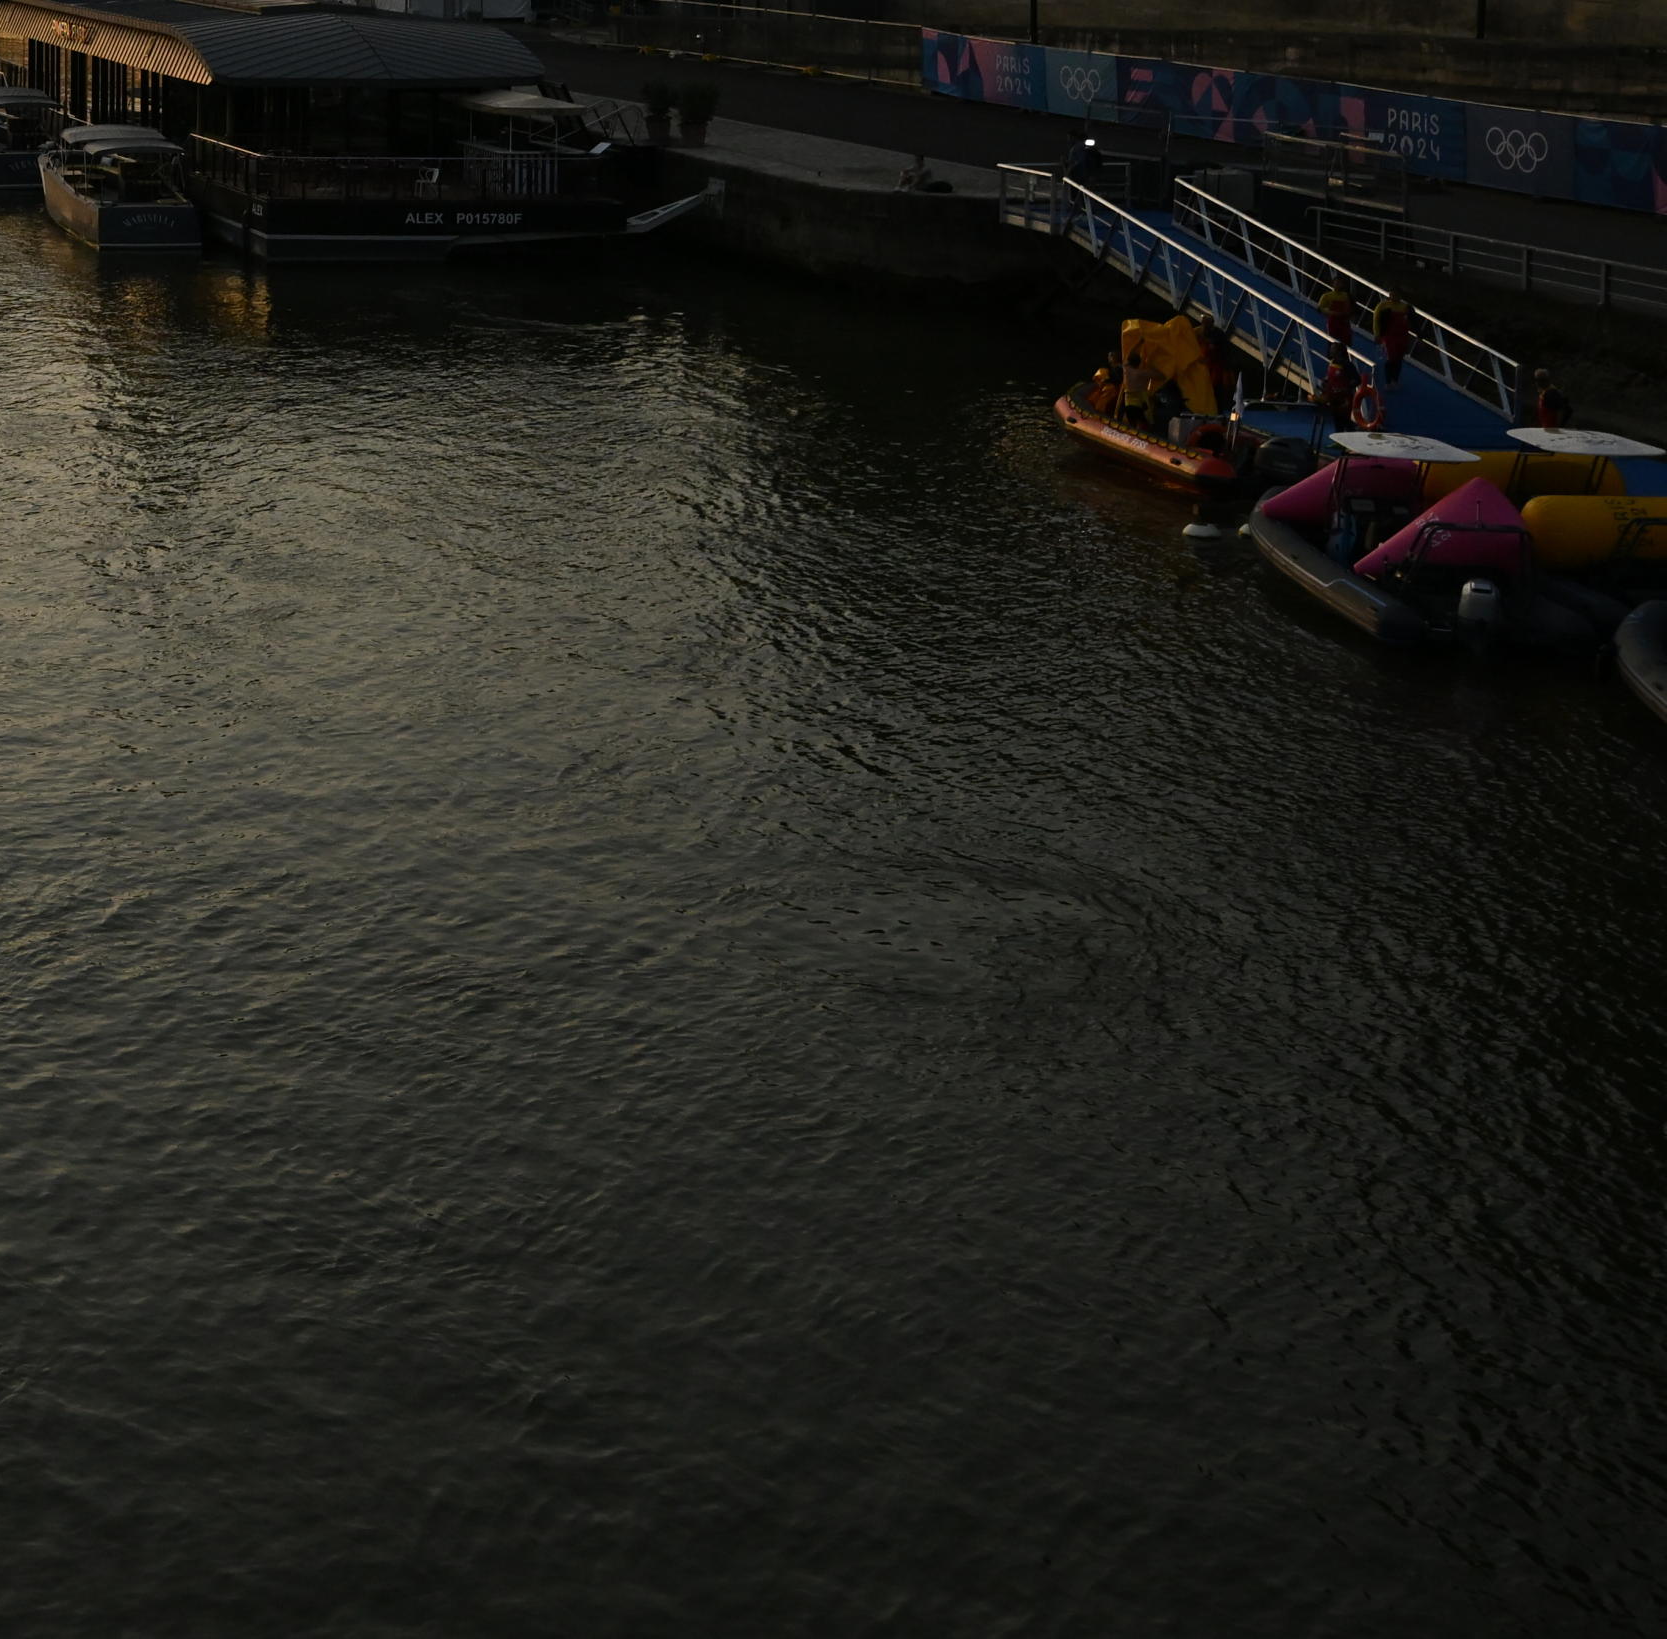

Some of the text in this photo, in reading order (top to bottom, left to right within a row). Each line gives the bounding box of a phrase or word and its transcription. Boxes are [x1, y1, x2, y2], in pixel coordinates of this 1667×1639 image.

[996, 54, 1030, 74] PARIS
[997, 75, 1032, 95] 2024
[1387, 108, 1440, 136] PARIS
[1388, 133, 1441, 162] 2024
[404, 212, 524, 225] ALEX P015780F
